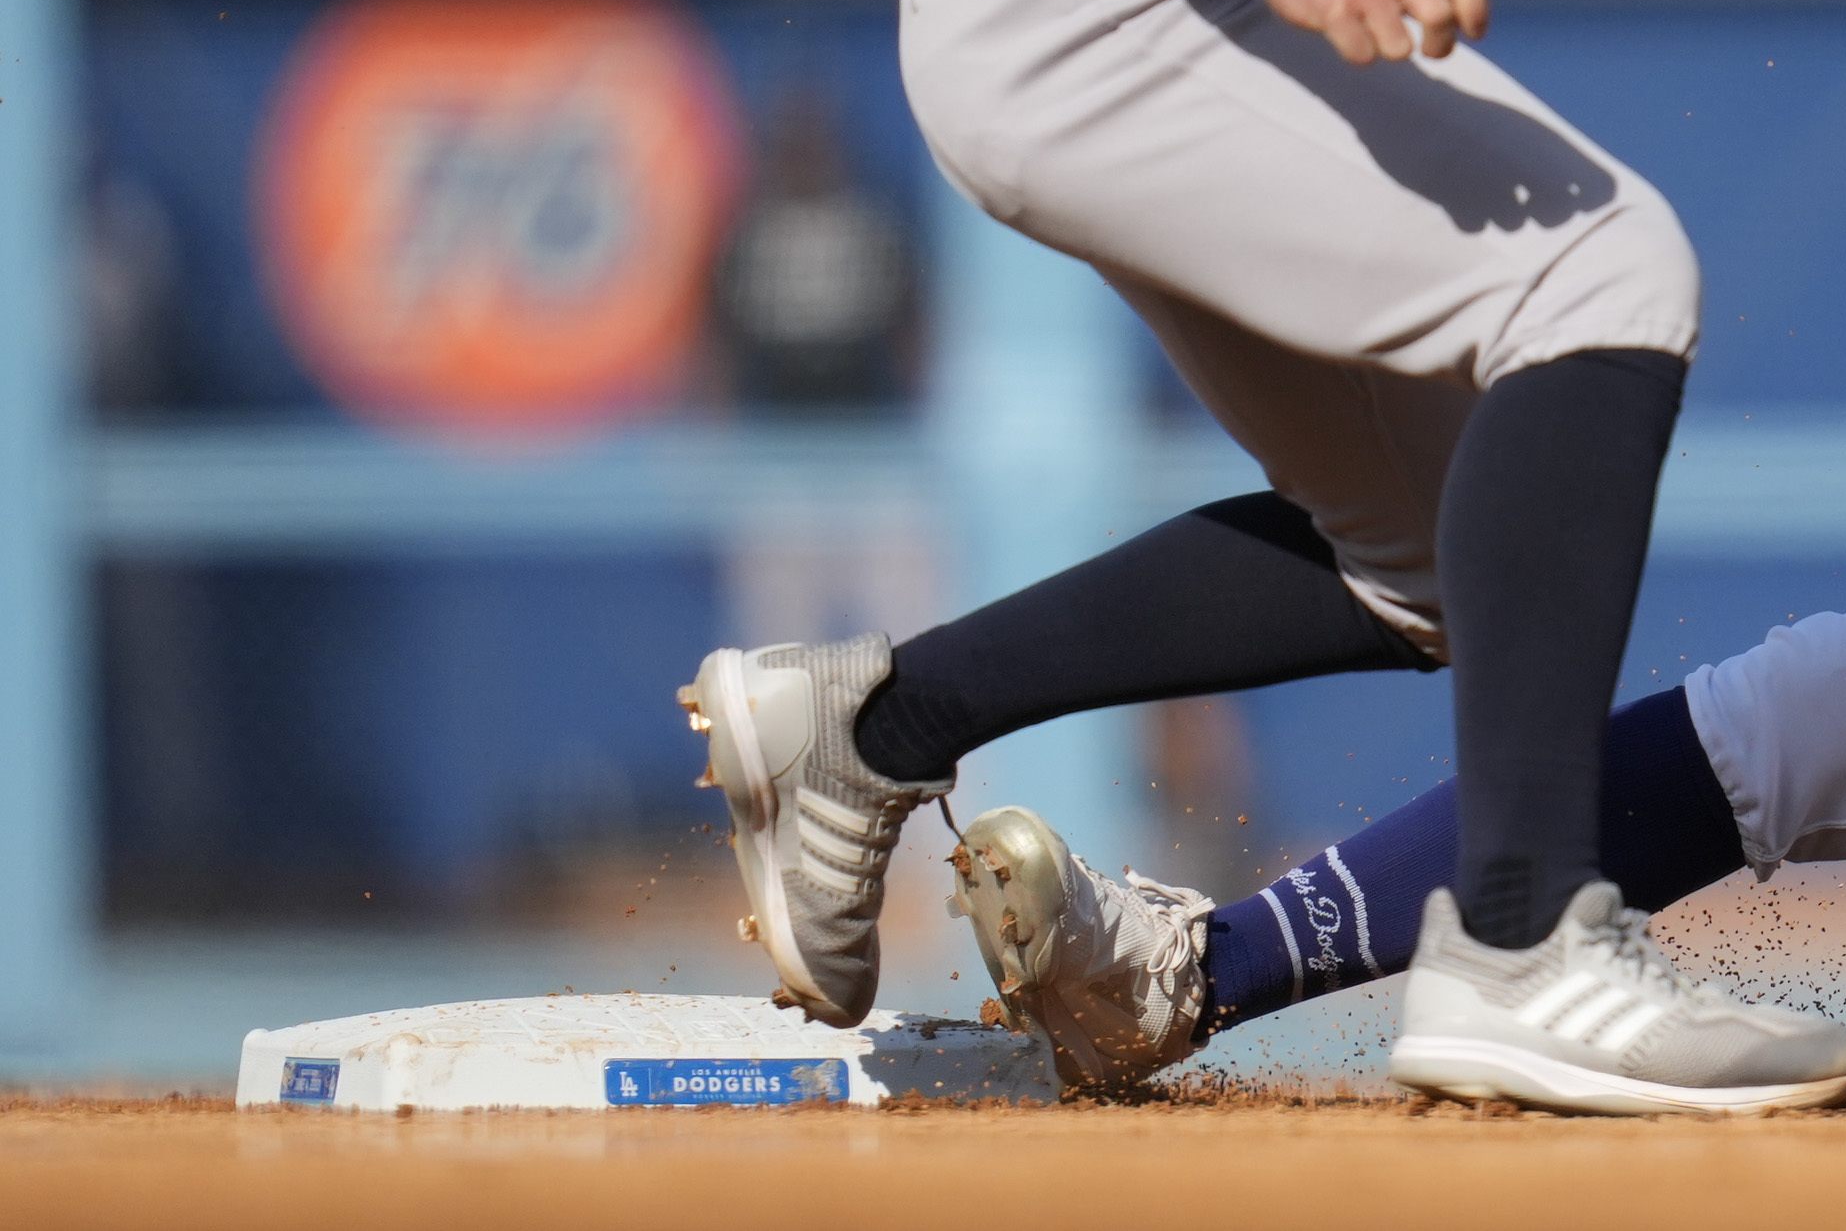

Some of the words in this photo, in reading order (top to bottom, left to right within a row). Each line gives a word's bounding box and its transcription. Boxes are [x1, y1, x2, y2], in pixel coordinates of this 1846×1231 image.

[691, 1068, 711, 1076] LOS
[716, 1068, 763, 1076] ANGELES
[619, 1071, 639, 1097] LA
[673, 1076, 782, 1093] DODGERS
